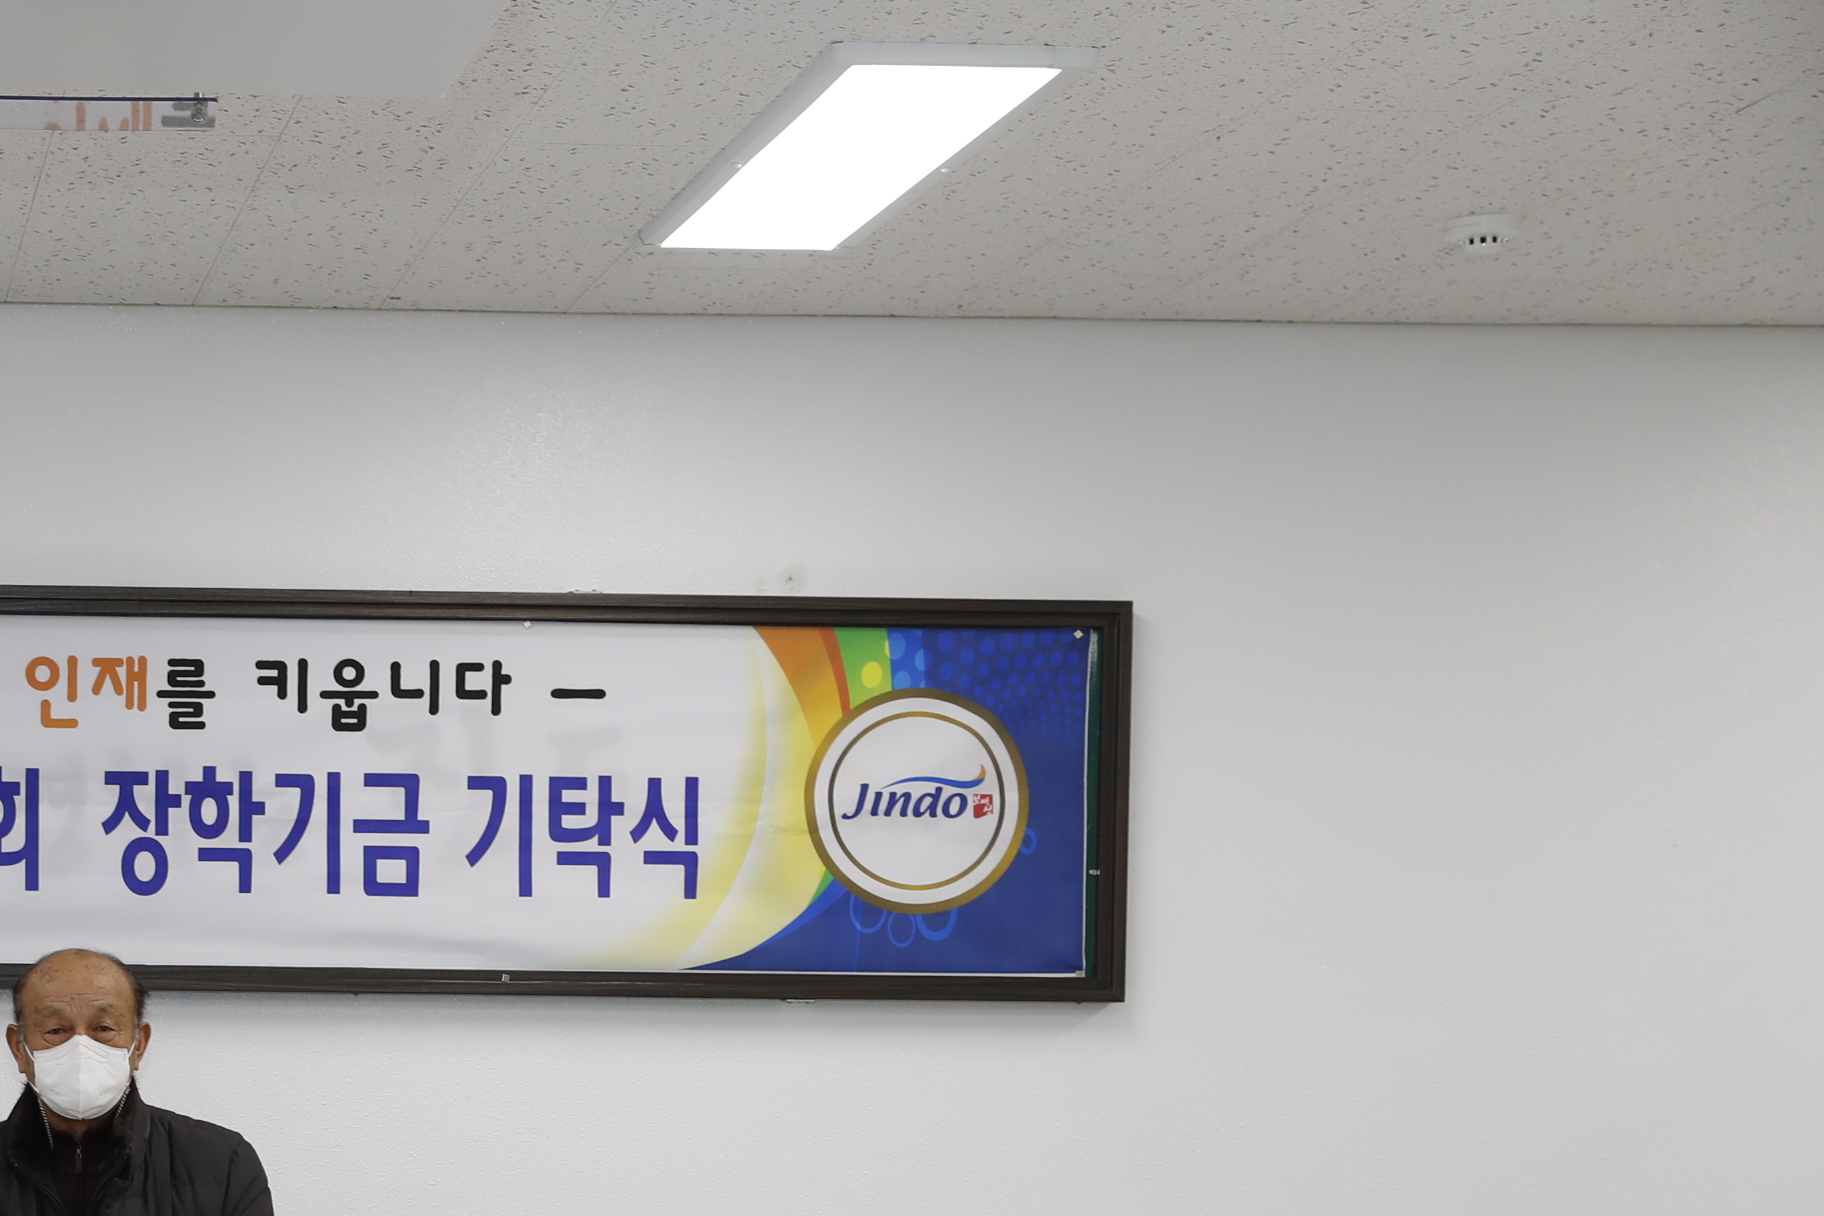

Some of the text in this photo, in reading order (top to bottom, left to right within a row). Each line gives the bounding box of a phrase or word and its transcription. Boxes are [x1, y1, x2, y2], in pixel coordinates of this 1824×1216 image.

[24, 654, 217, 731] 인재를
[254, 657, 513, 733] 키웁니다
[100, 765, 430, 898] 장학기금
[464, 773, 700, 900] 기탁식
[841, 783, 968, 820] Jindo
